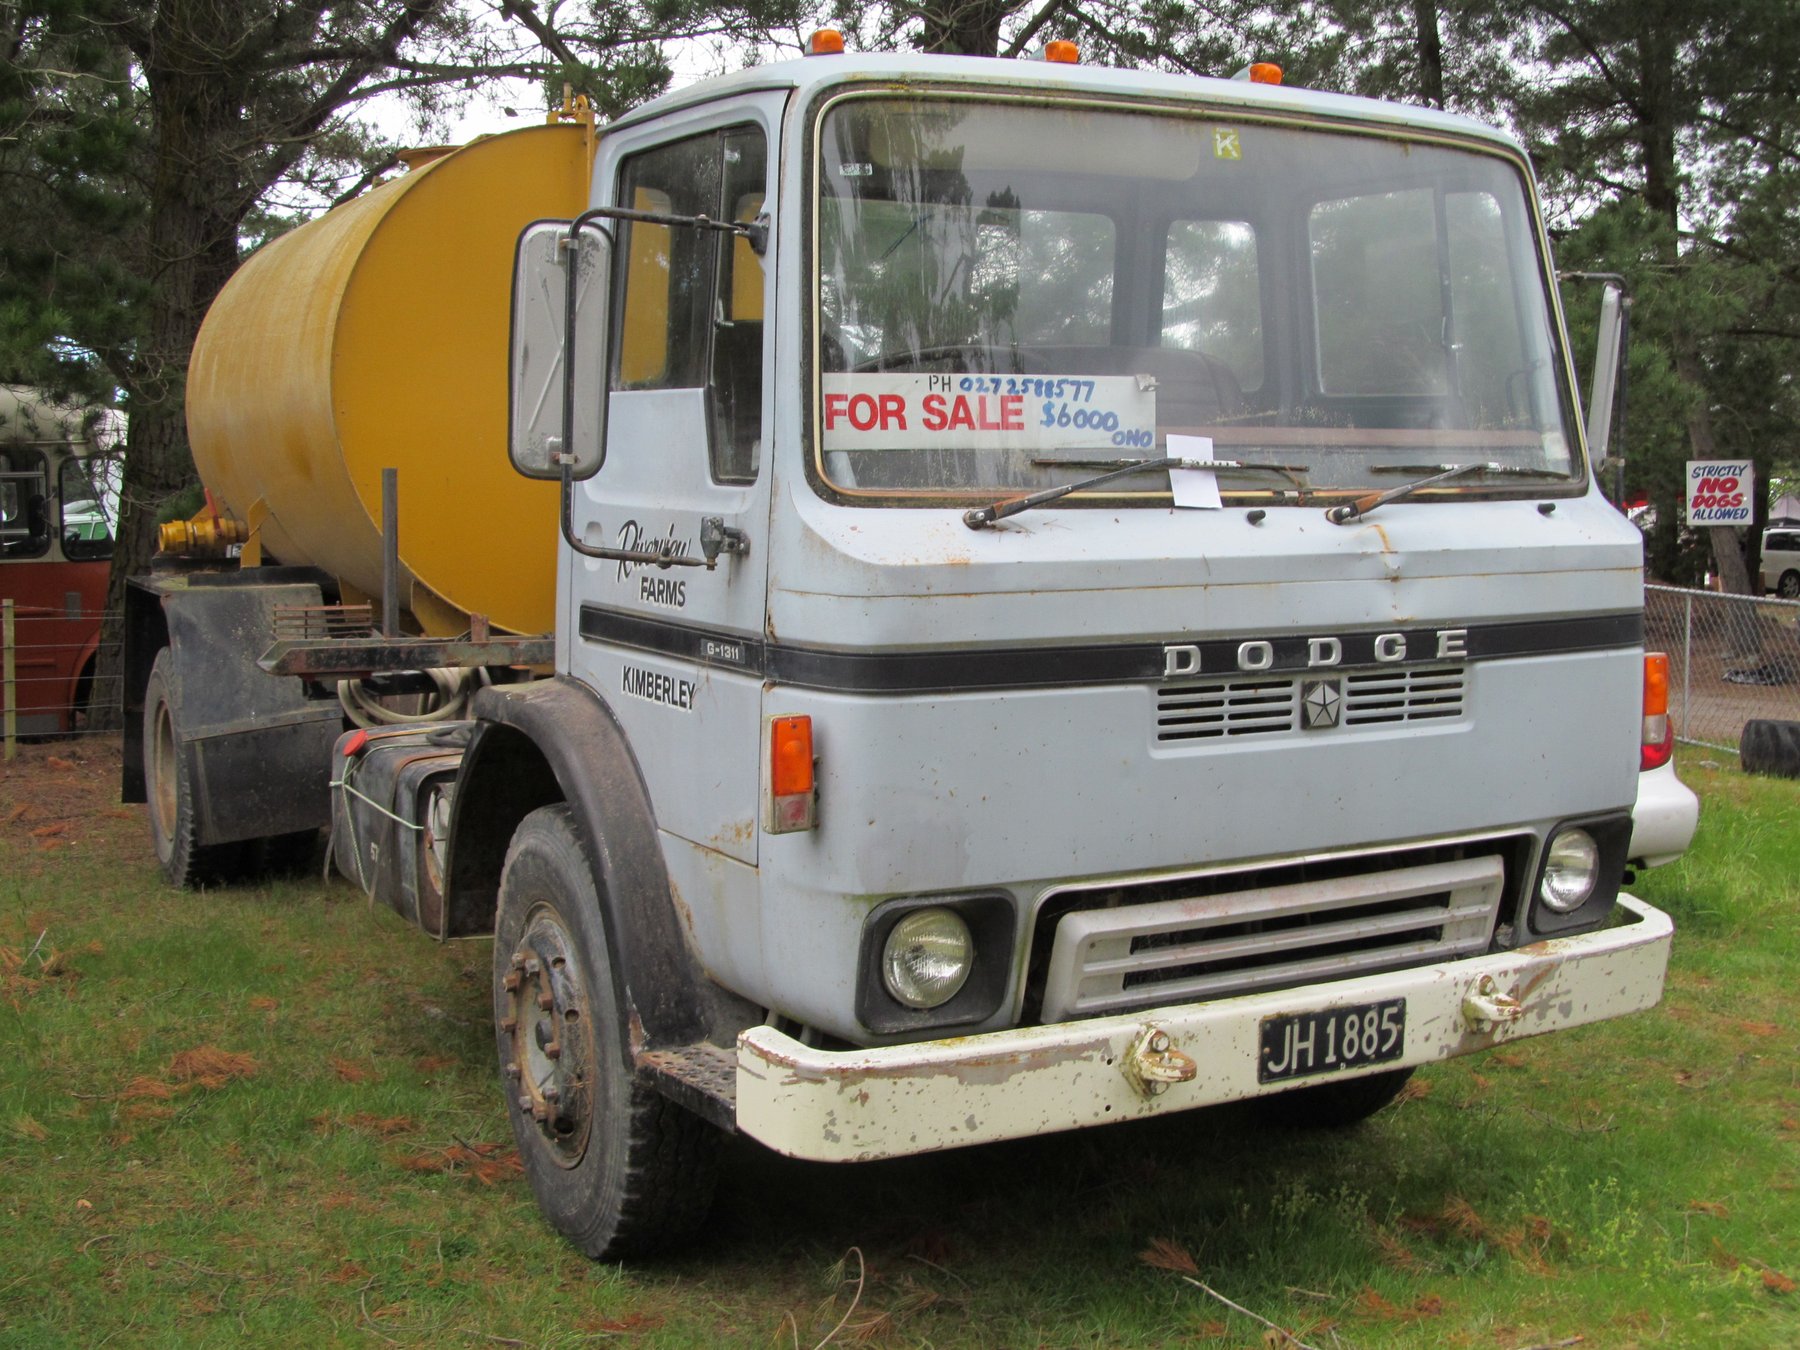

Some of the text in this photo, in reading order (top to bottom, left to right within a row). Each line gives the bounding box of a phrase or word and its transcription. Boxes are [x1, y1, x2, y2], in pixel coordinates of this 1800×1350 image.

[1216, 133, 1238, 157] K
[929, 375, 951, 392] PH
[825, 394, 1025, 431] FOR SALE
[1040, 401, 1119, 431] $6000
[1112, 430, 1153, 447] ONO
[1691, 464, 1748, 478] STRICTLY
[1697, 477, 1739, 493] NO
[1691, 493, 1743, 508] DOGS
[1692, 508, 1749, 520] ALLOWED
[640, 576, 687, 608] FARMS
[706, 642, 740, 661] G-1311
[1164, 629, 1467, 676] DODGE
[622, 665, 696, 711] KIMBERLEY
[1267, 1006, 1398, 1073] JH 1885
